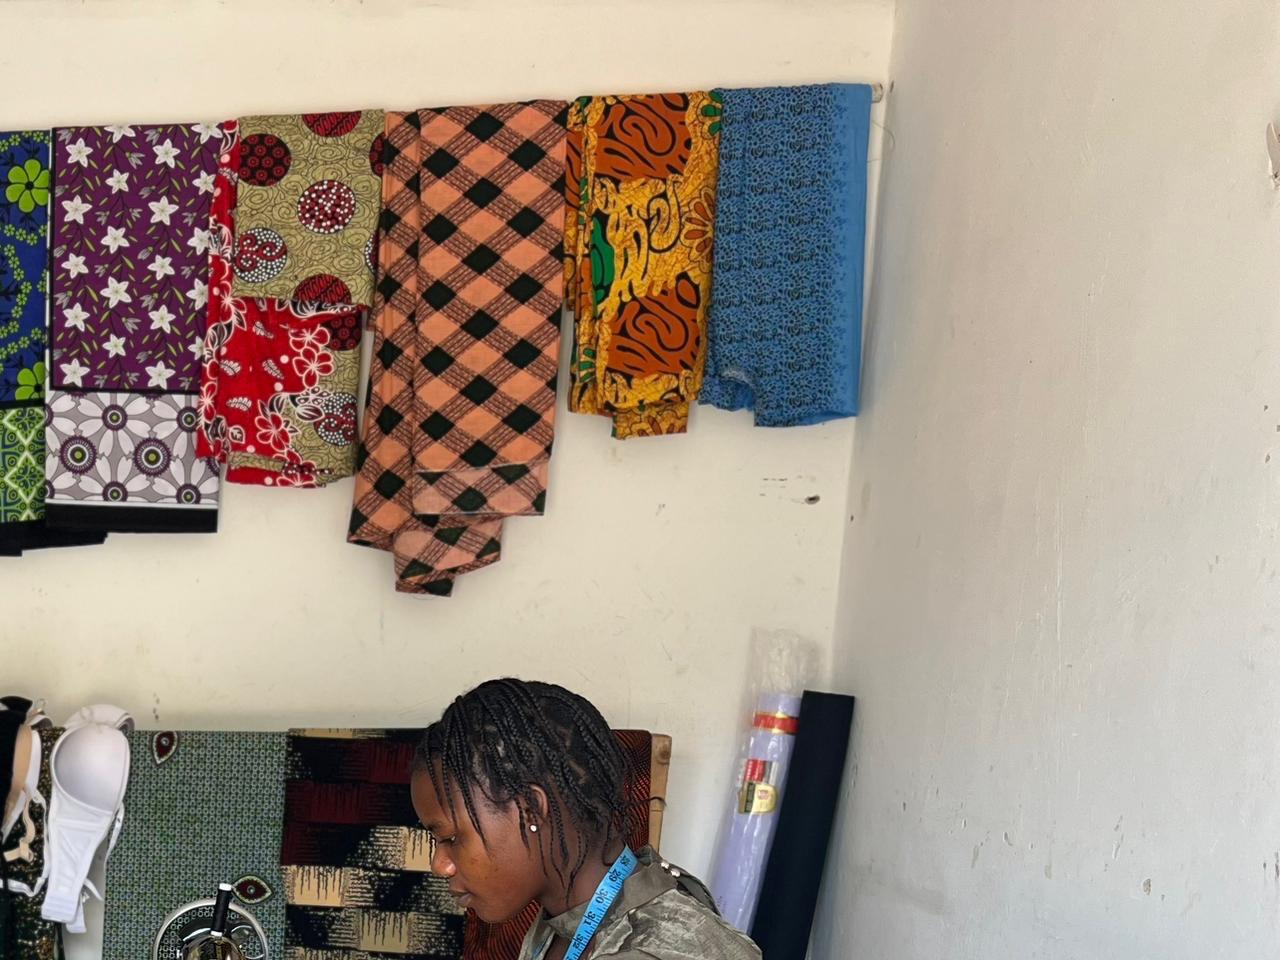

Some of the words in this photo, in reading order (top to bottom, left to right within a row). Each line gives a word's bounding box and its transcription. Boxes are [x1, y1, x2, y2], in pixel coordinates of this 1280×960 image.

[608, 868, 621, 882] 29
[595, 888, 608, 904] 30
[584, 911, 596, 926] 31
[572, 933, 584, 949] 32
